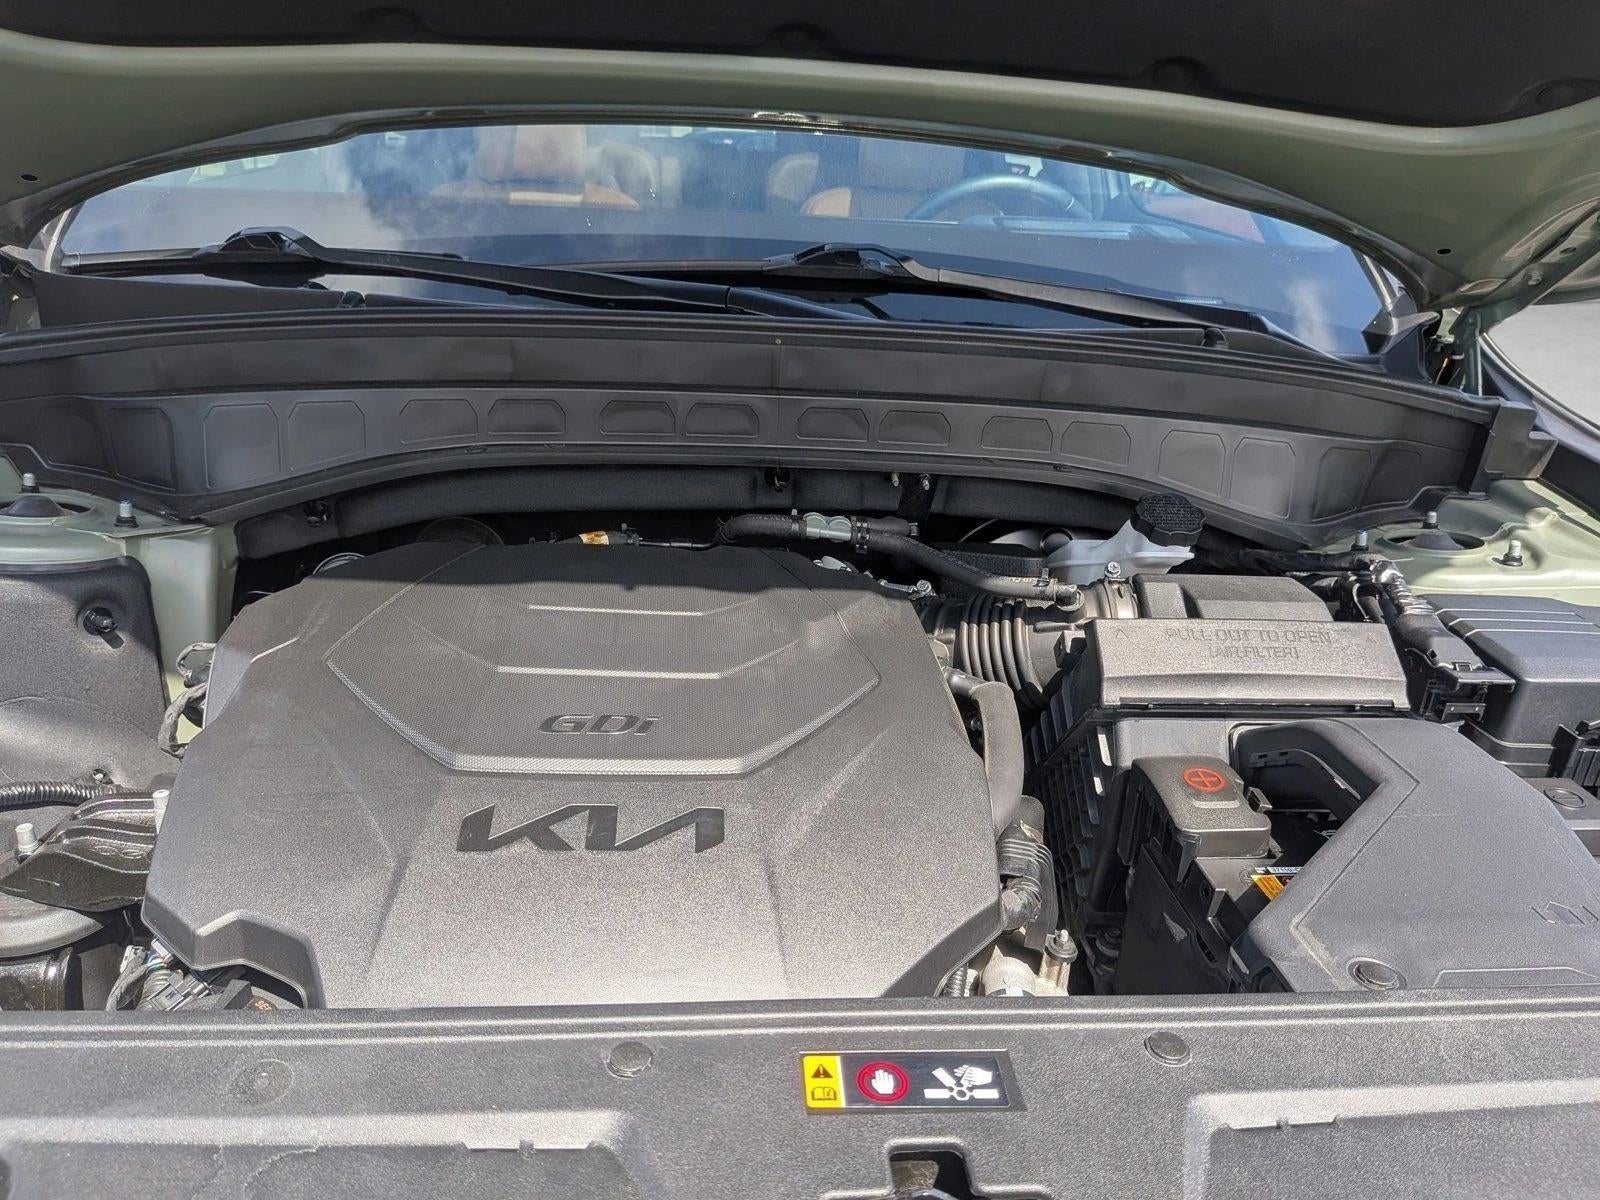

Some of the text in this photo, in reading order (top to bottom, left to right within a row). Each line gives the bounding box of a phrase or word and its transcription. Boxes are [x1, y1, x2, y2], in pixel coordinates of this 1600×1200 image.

[1165, 628, 1332, 644] PULL OUT TO OPEN
[456, 803, 725, 853] KIA
